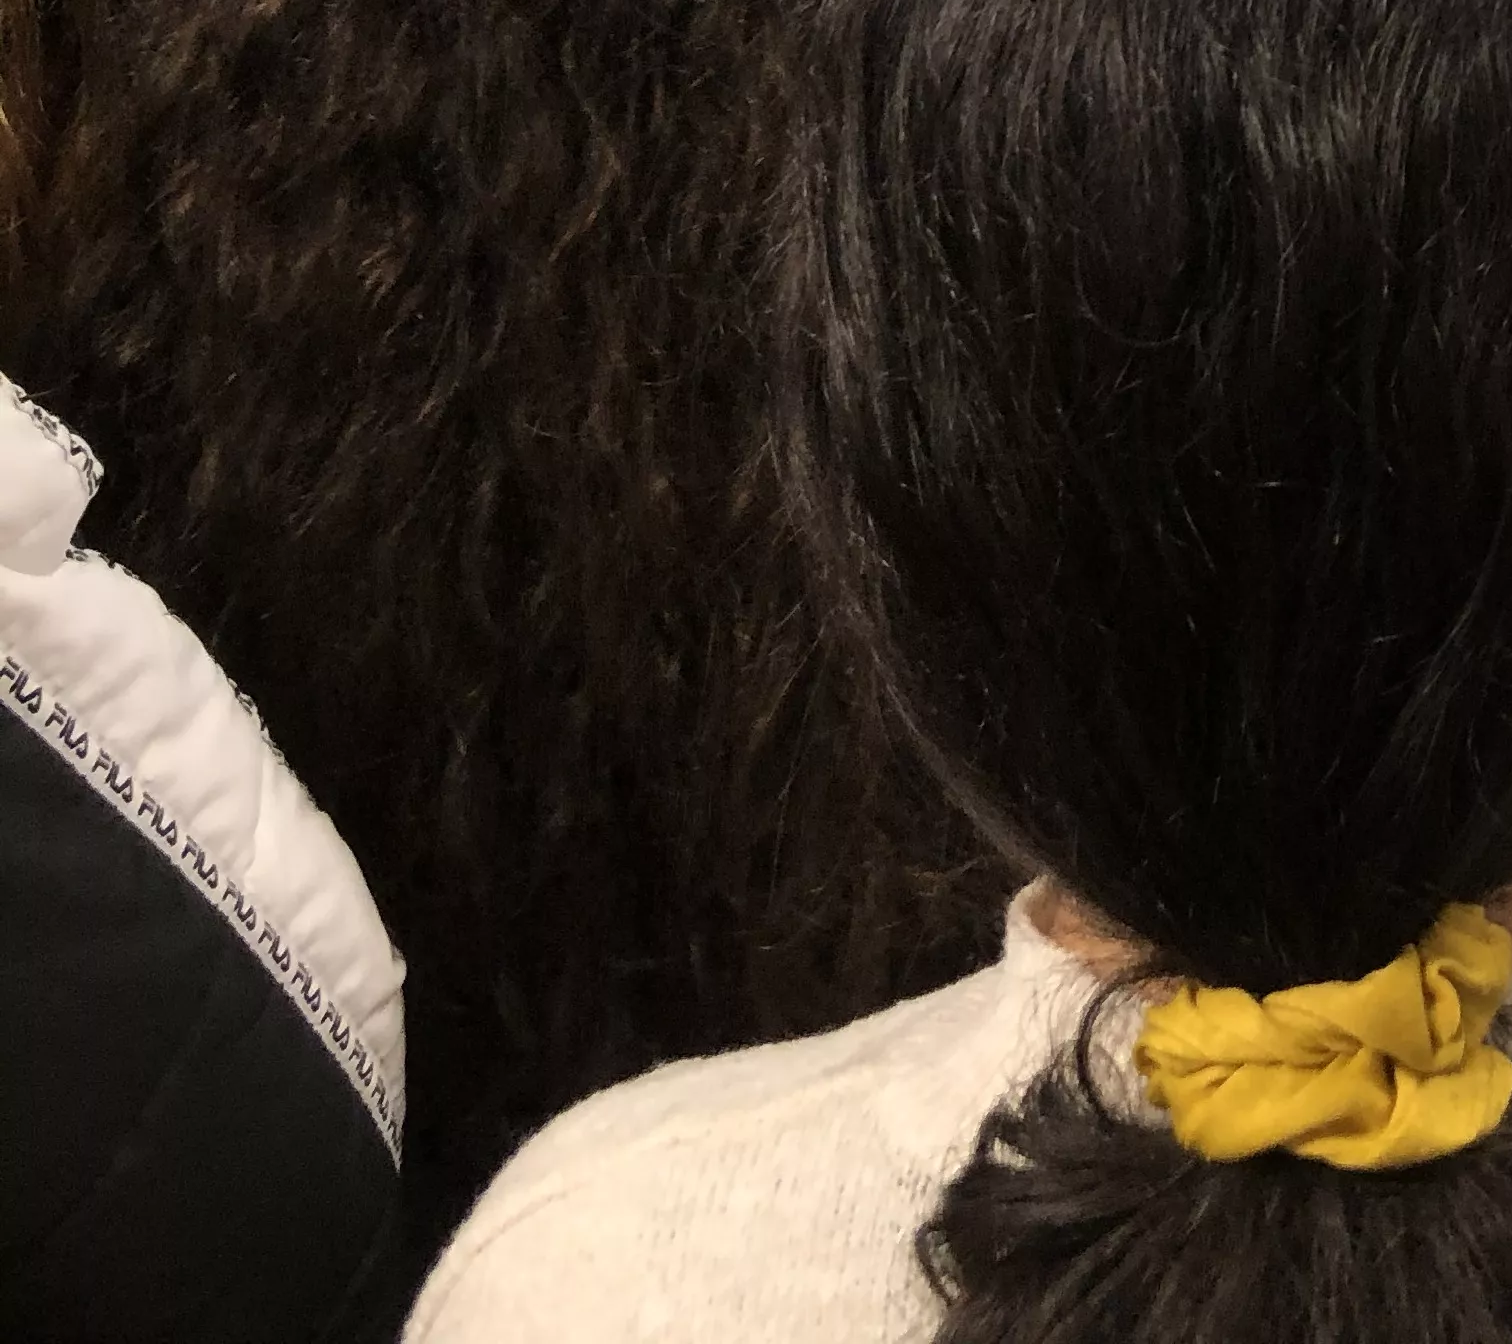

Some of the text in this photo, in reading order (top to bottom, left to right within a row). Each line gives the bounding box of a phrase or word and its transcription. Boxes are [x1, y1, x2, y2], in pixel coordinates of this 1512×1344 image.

[0, 656, 42, 714] FILA
[45, 701, 88, 759] FILA
[92, 748, 133, 803] FILA
[137, 791, 177, 847] FILA
[181, 835, 218, 889] FILA
[222, 877, 257, 931] FILA
[258, 920, 291, 972] FILA
[291, 961, 321, 1012] FILA
[321, 1000, 350, 1051] FILA
[349, 1038, 374, 1087] FILA
